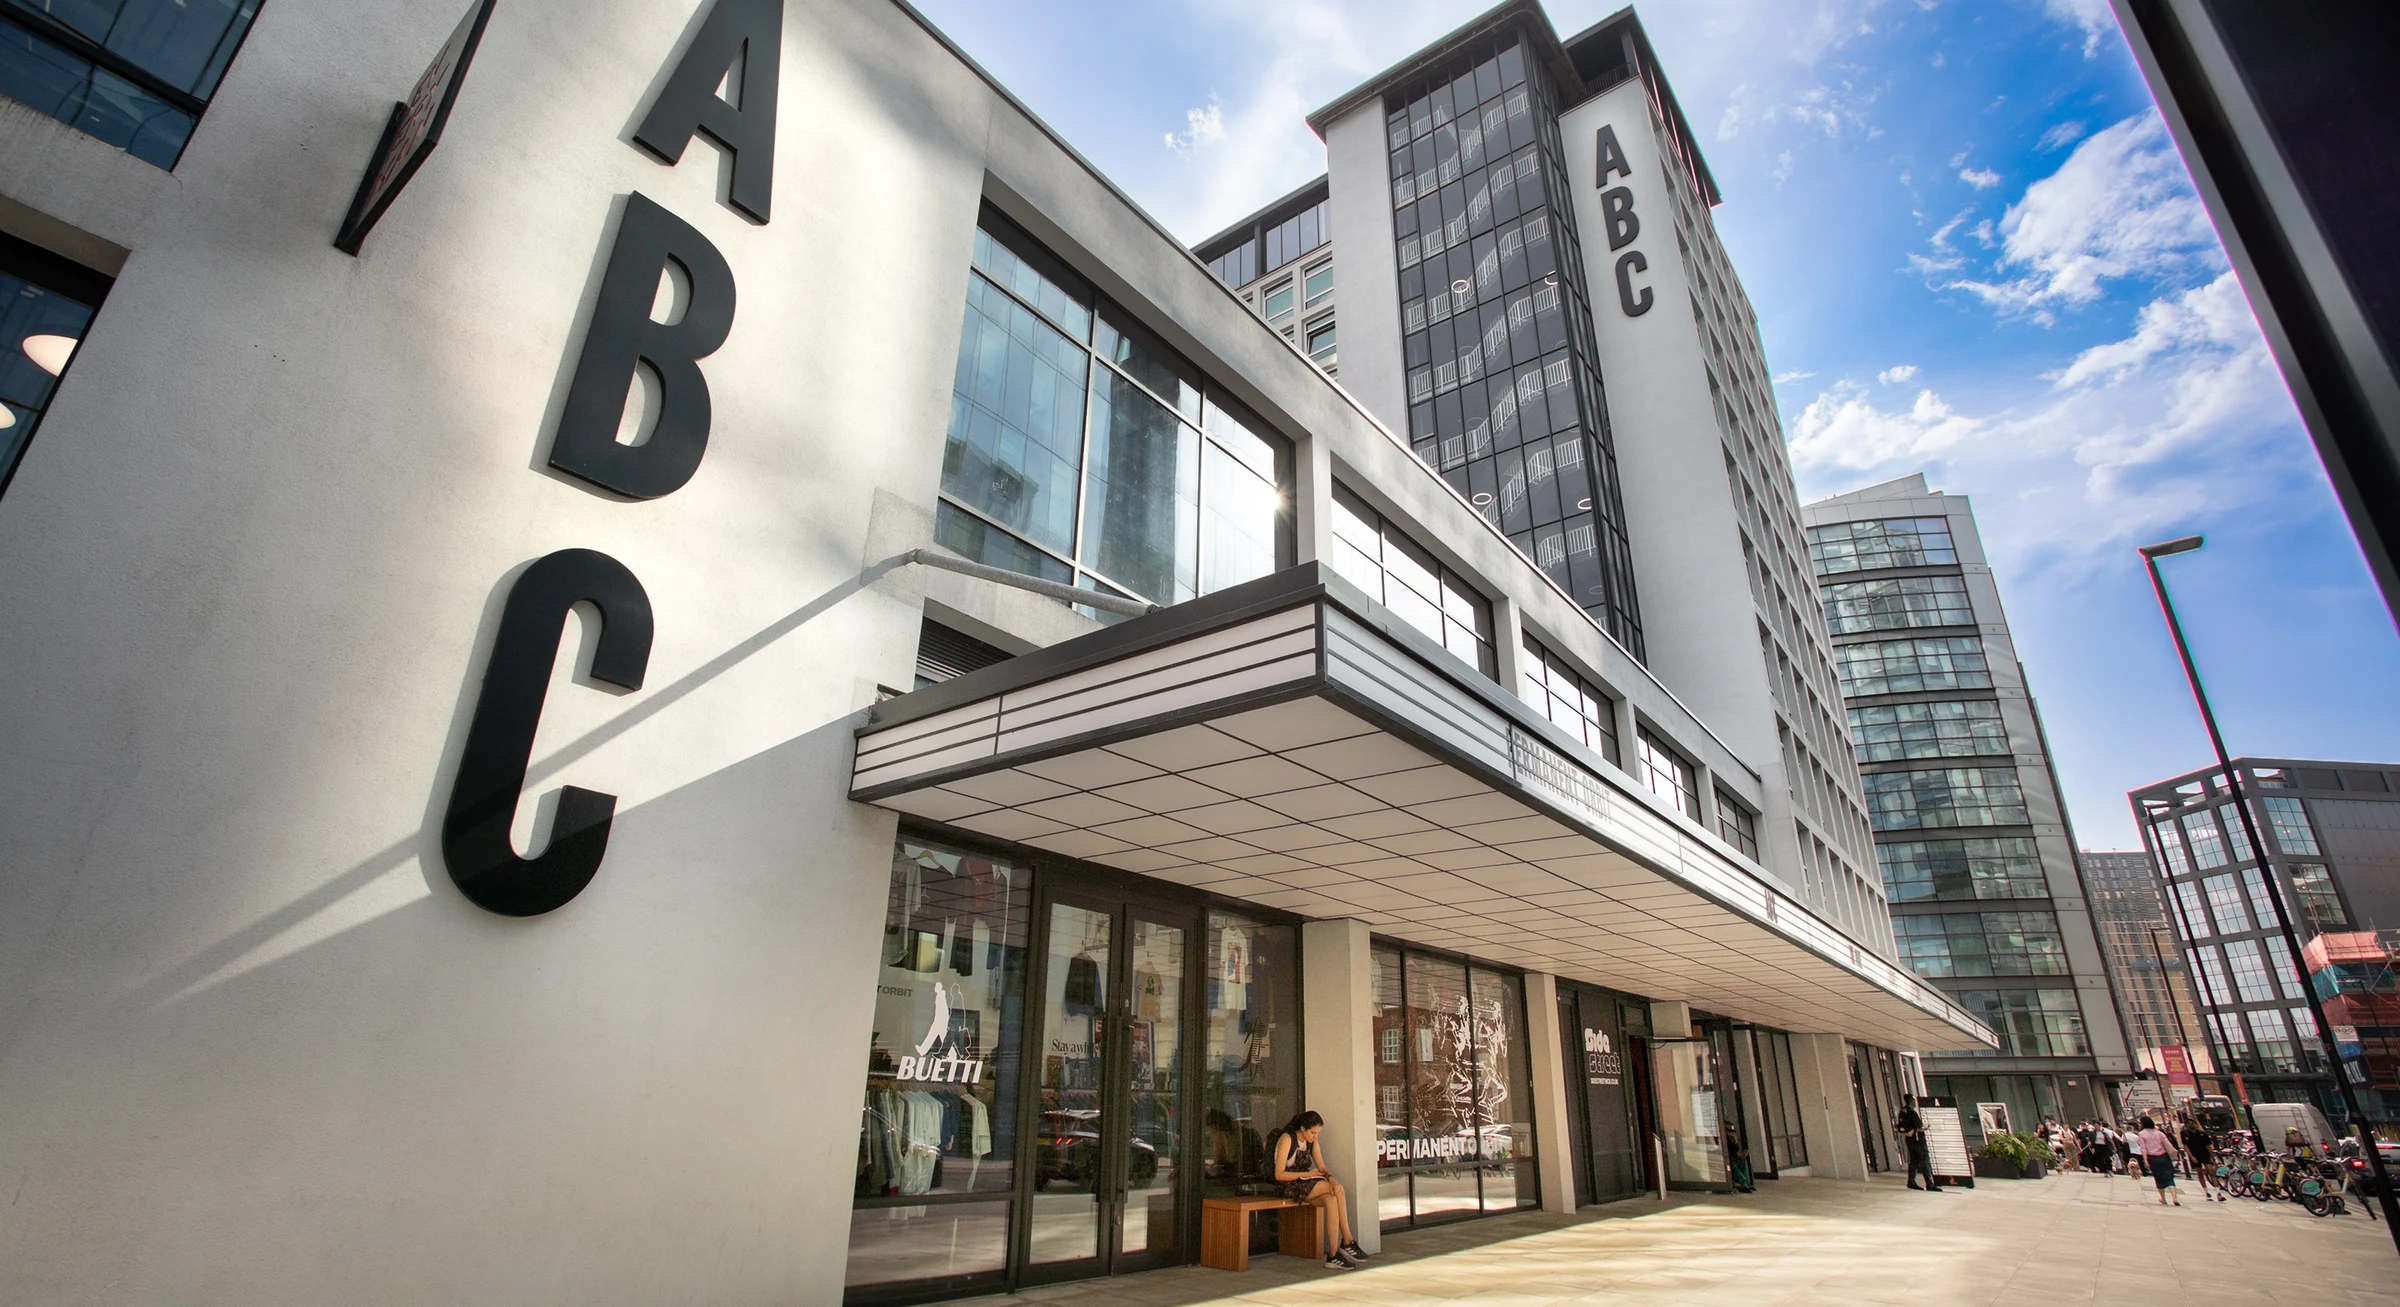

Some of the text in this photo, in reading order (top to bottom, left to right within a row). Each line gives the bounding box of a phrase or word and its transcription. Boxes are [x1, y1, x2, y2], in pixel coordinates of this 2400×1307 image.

[1596, 124, 1654, 318] ABC
[441, 0, 784, 918] ABC
[1582, 774, 1612, 825] ORBIT
[882, 986, 914, 998] ORBIT
[897, 1055, 983, 1084] BUETTI
